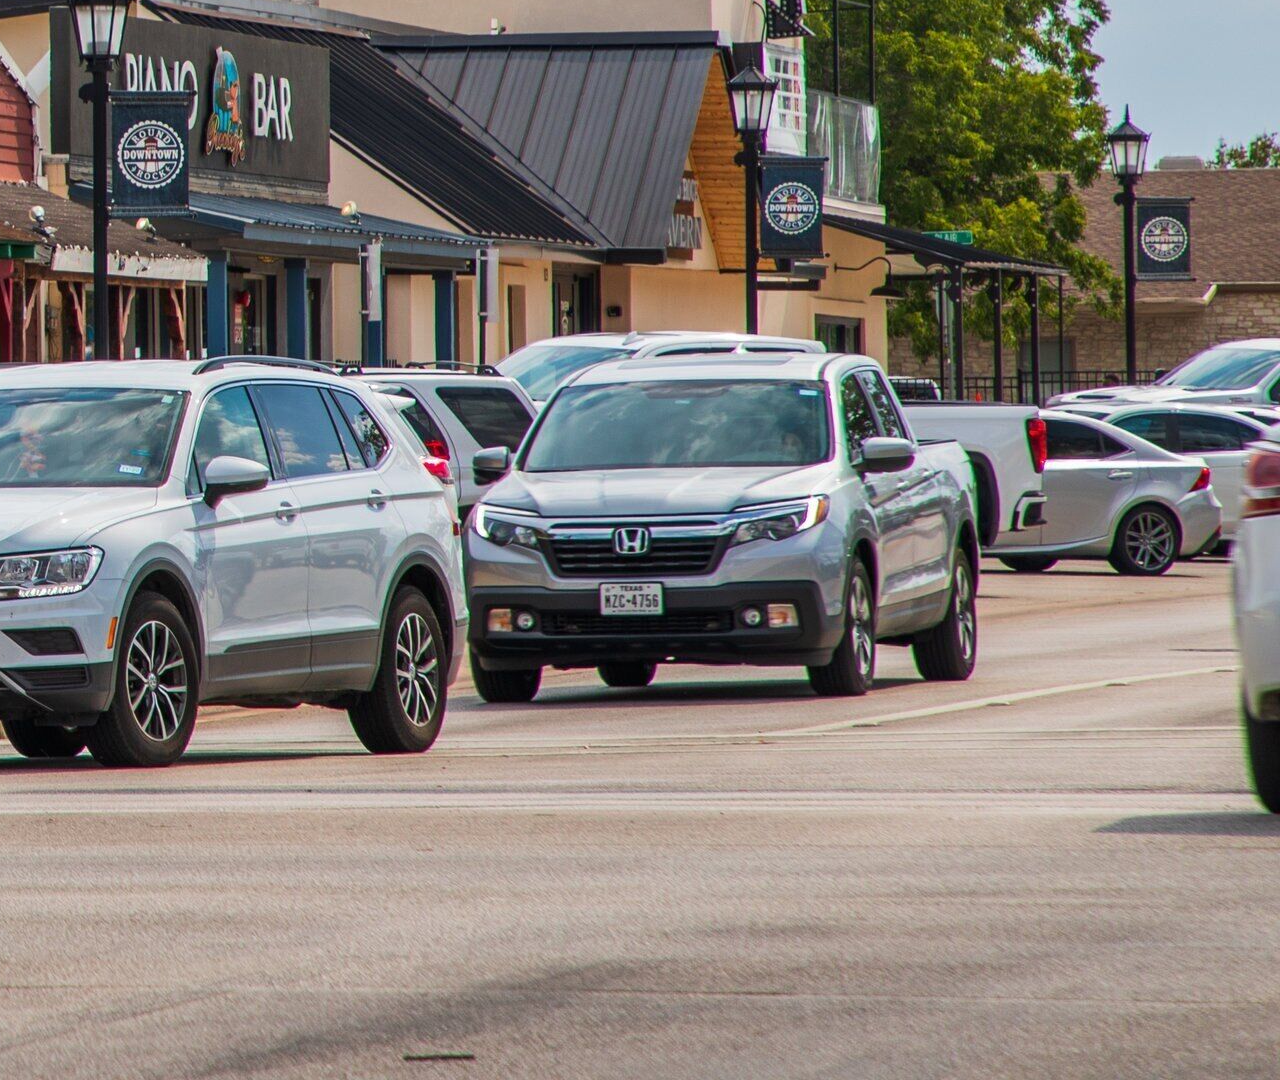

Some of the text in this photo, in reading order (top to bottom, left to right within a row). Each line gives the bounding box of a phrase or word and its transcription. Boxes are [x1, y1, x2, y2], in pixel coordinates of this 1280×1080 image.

[253, 72, 294, 142] BAR
[132, 128, 172, 146] ROUND
[123, 148, 179, 160] DOWNTOWN
[136, 168, 168, 181] ROCK
[777, 187, 809, 201] ROUND
[769, 203, 815, 213] DOWNTOWN
[779, 219, 804, 229] ROCK
[668, 214, 703, 250] VERN
[1145, 235, 1184, 243] DOWNTOWN
